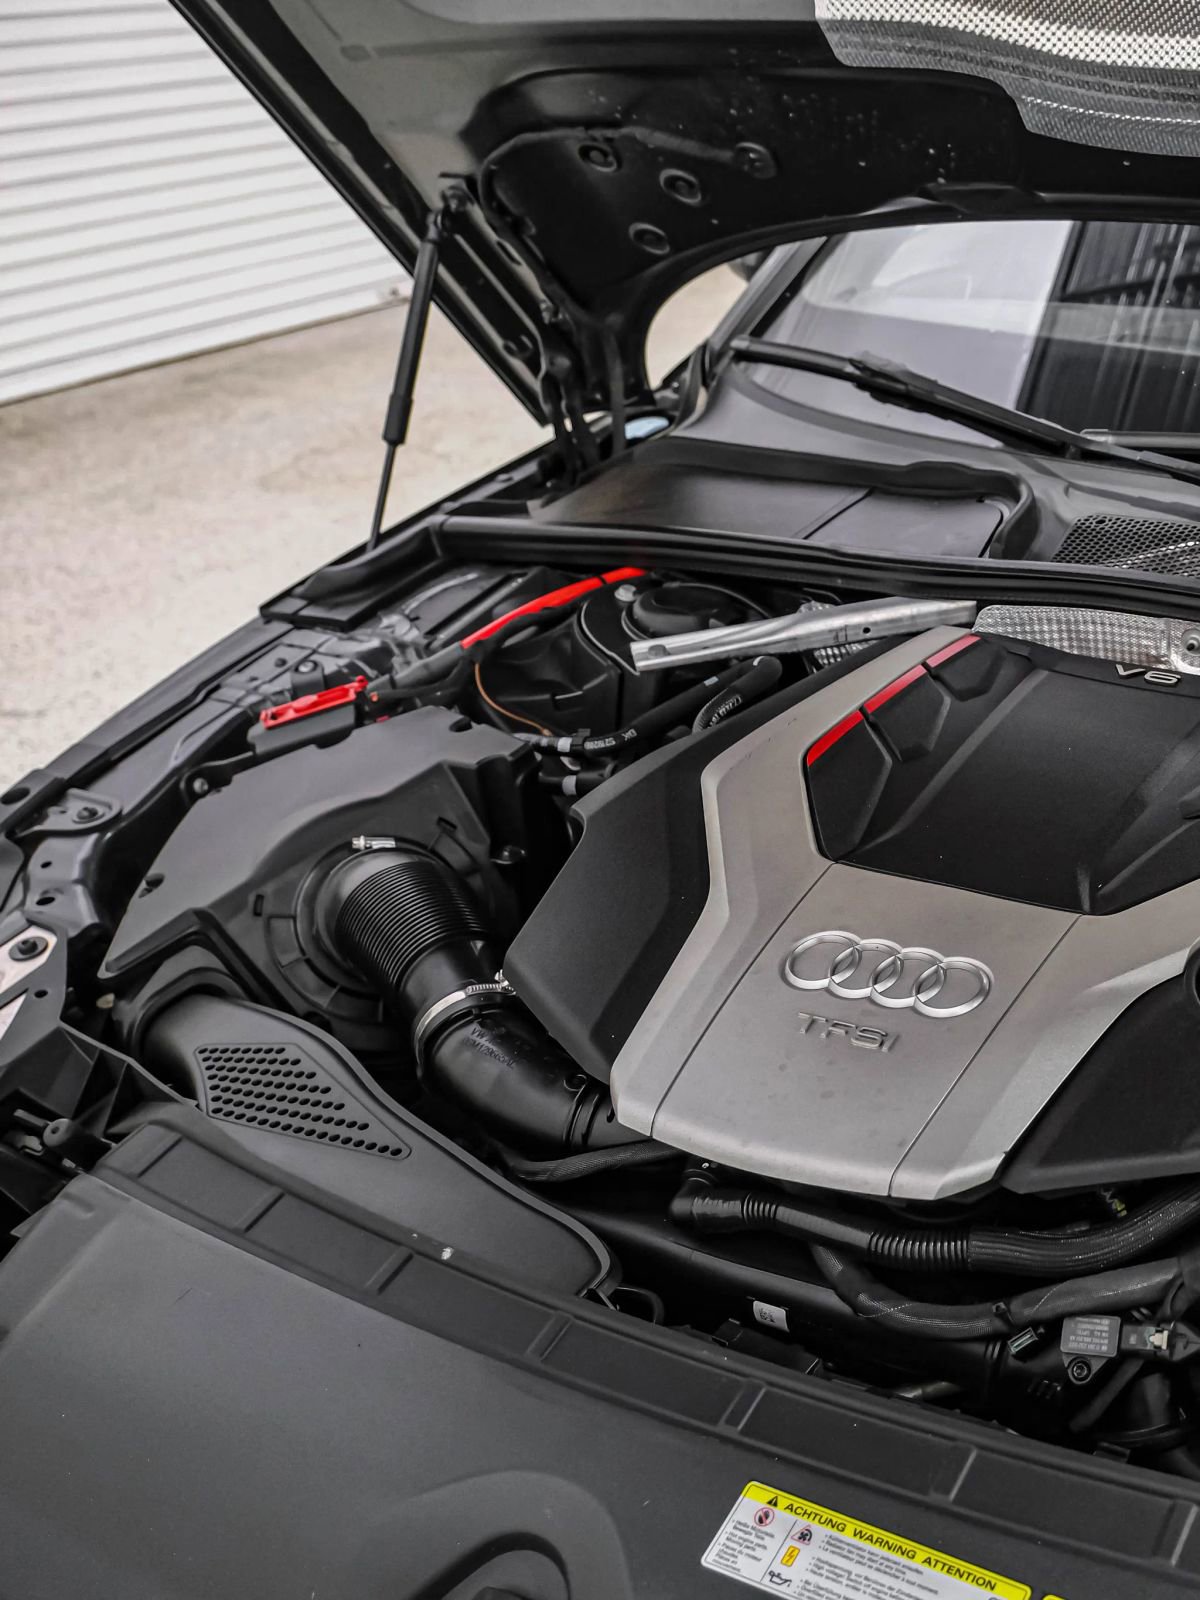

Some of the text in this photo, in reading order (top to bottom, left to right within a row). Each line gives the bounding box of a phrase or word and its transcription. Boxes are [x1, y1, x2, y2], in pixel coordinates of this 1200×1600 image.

[1115, 664, 1182, 685] V6
[798, 1012, 899, 1052] TFSI
[784, 1503, 846, 1532] ACHTUNG
[853, 1529, 916, 1559] WARNING
[921, 1555, 997, 1591] ATTENTION
